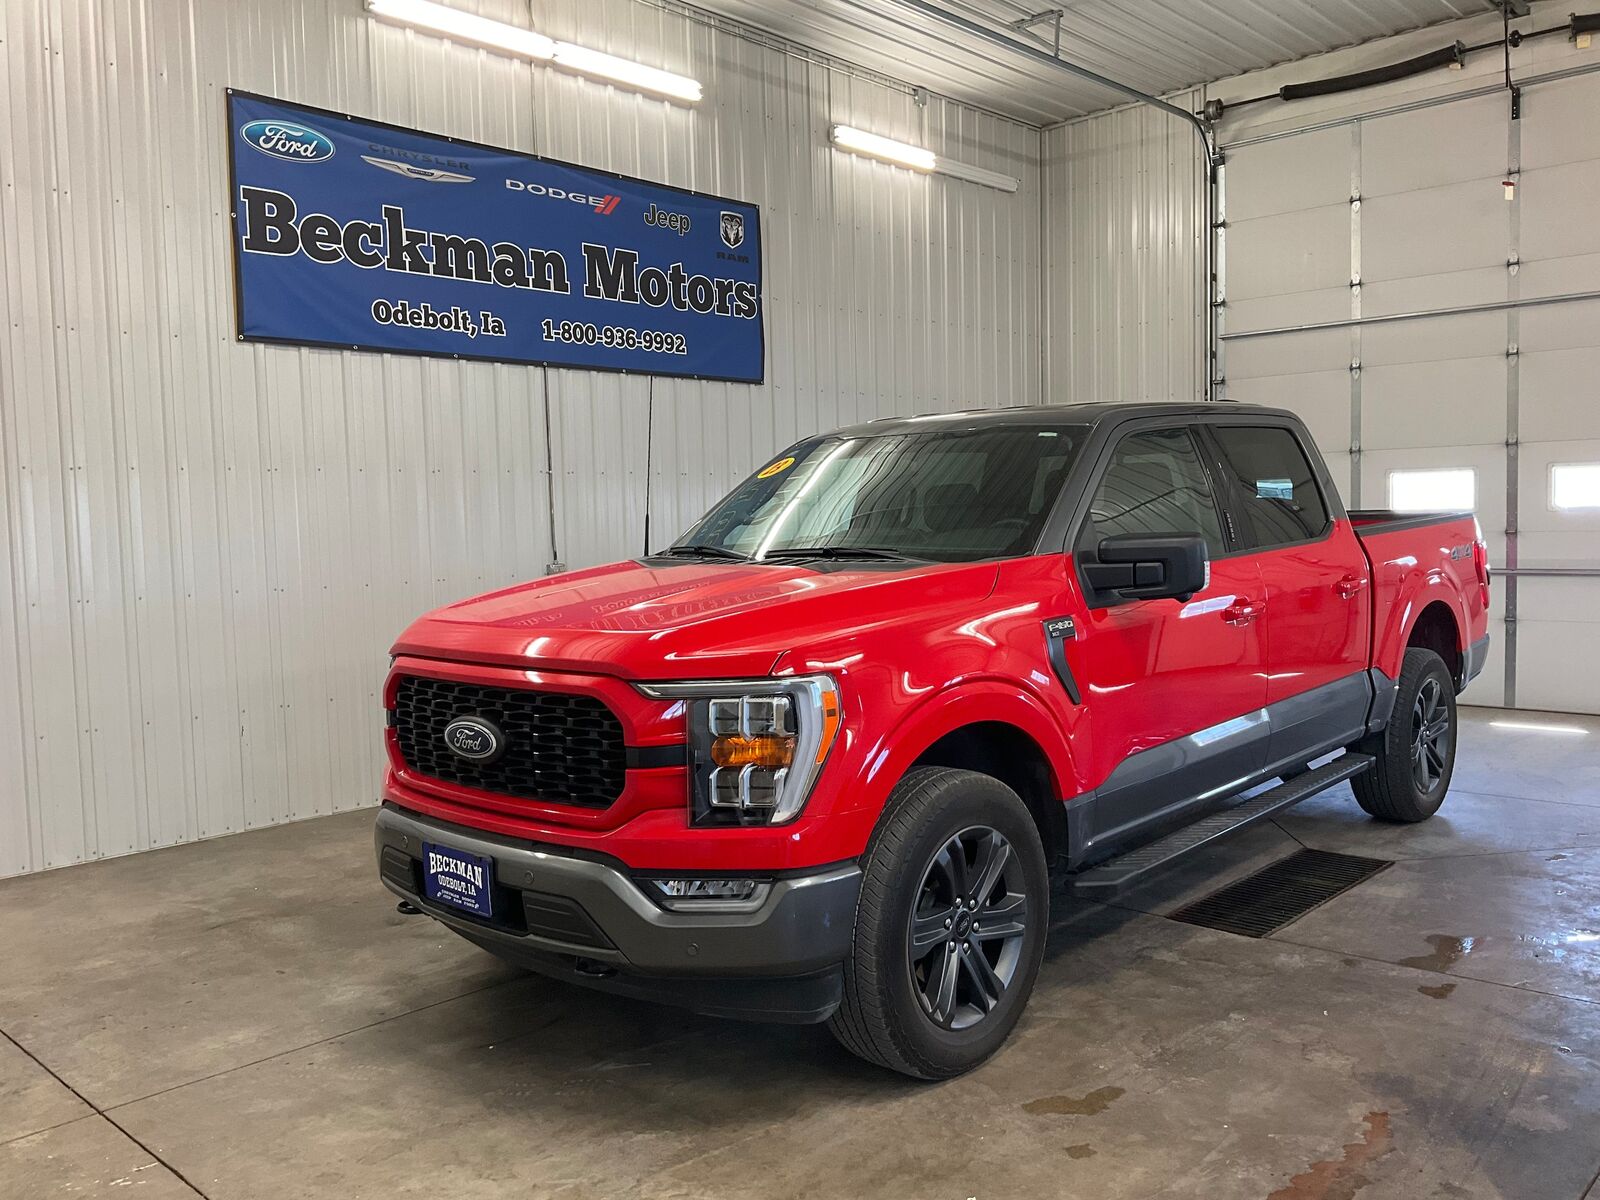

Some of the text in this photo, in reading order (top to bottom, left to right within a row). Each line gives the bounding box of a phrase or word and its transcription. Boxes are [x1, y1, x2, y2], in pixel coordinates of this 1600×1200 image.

[259, 124, 317, 159] Ford
[367, 141, 471, 171] CHRYSLER
[505, 179, 605, 208] DODGE
[643, 203, 692, 236] Jeep
[240, 185, 758, 319] Beckman Motors
[716, 251, 749, 263] RAM
[541, 318, 688, 355] 1-800-936-9992
[453, 728, 482, 751] Ford
[429, 852, 483, 889] BECKMAN
